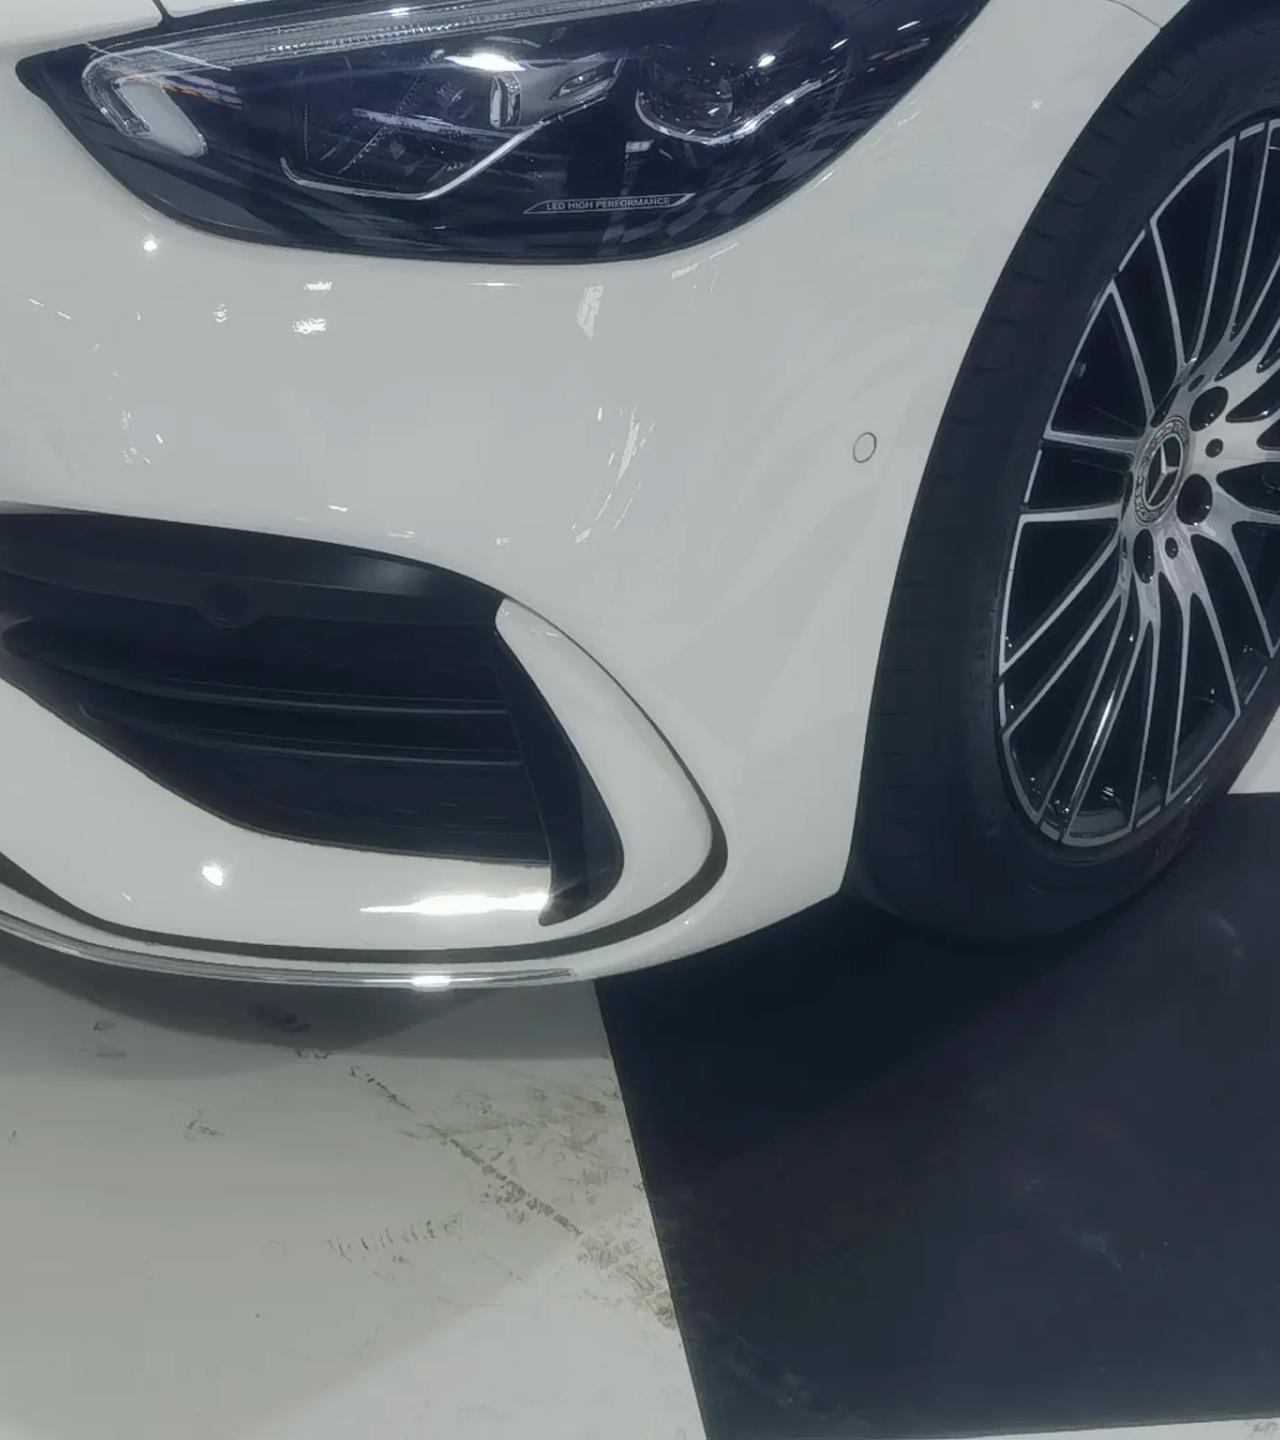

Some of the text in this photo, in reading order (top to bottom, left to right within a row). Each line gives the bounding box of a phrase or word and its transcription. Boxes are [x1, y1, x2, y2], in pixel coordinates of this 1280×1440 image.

[546, 196, 671, 211] LED HIGH PERFORMANCE
